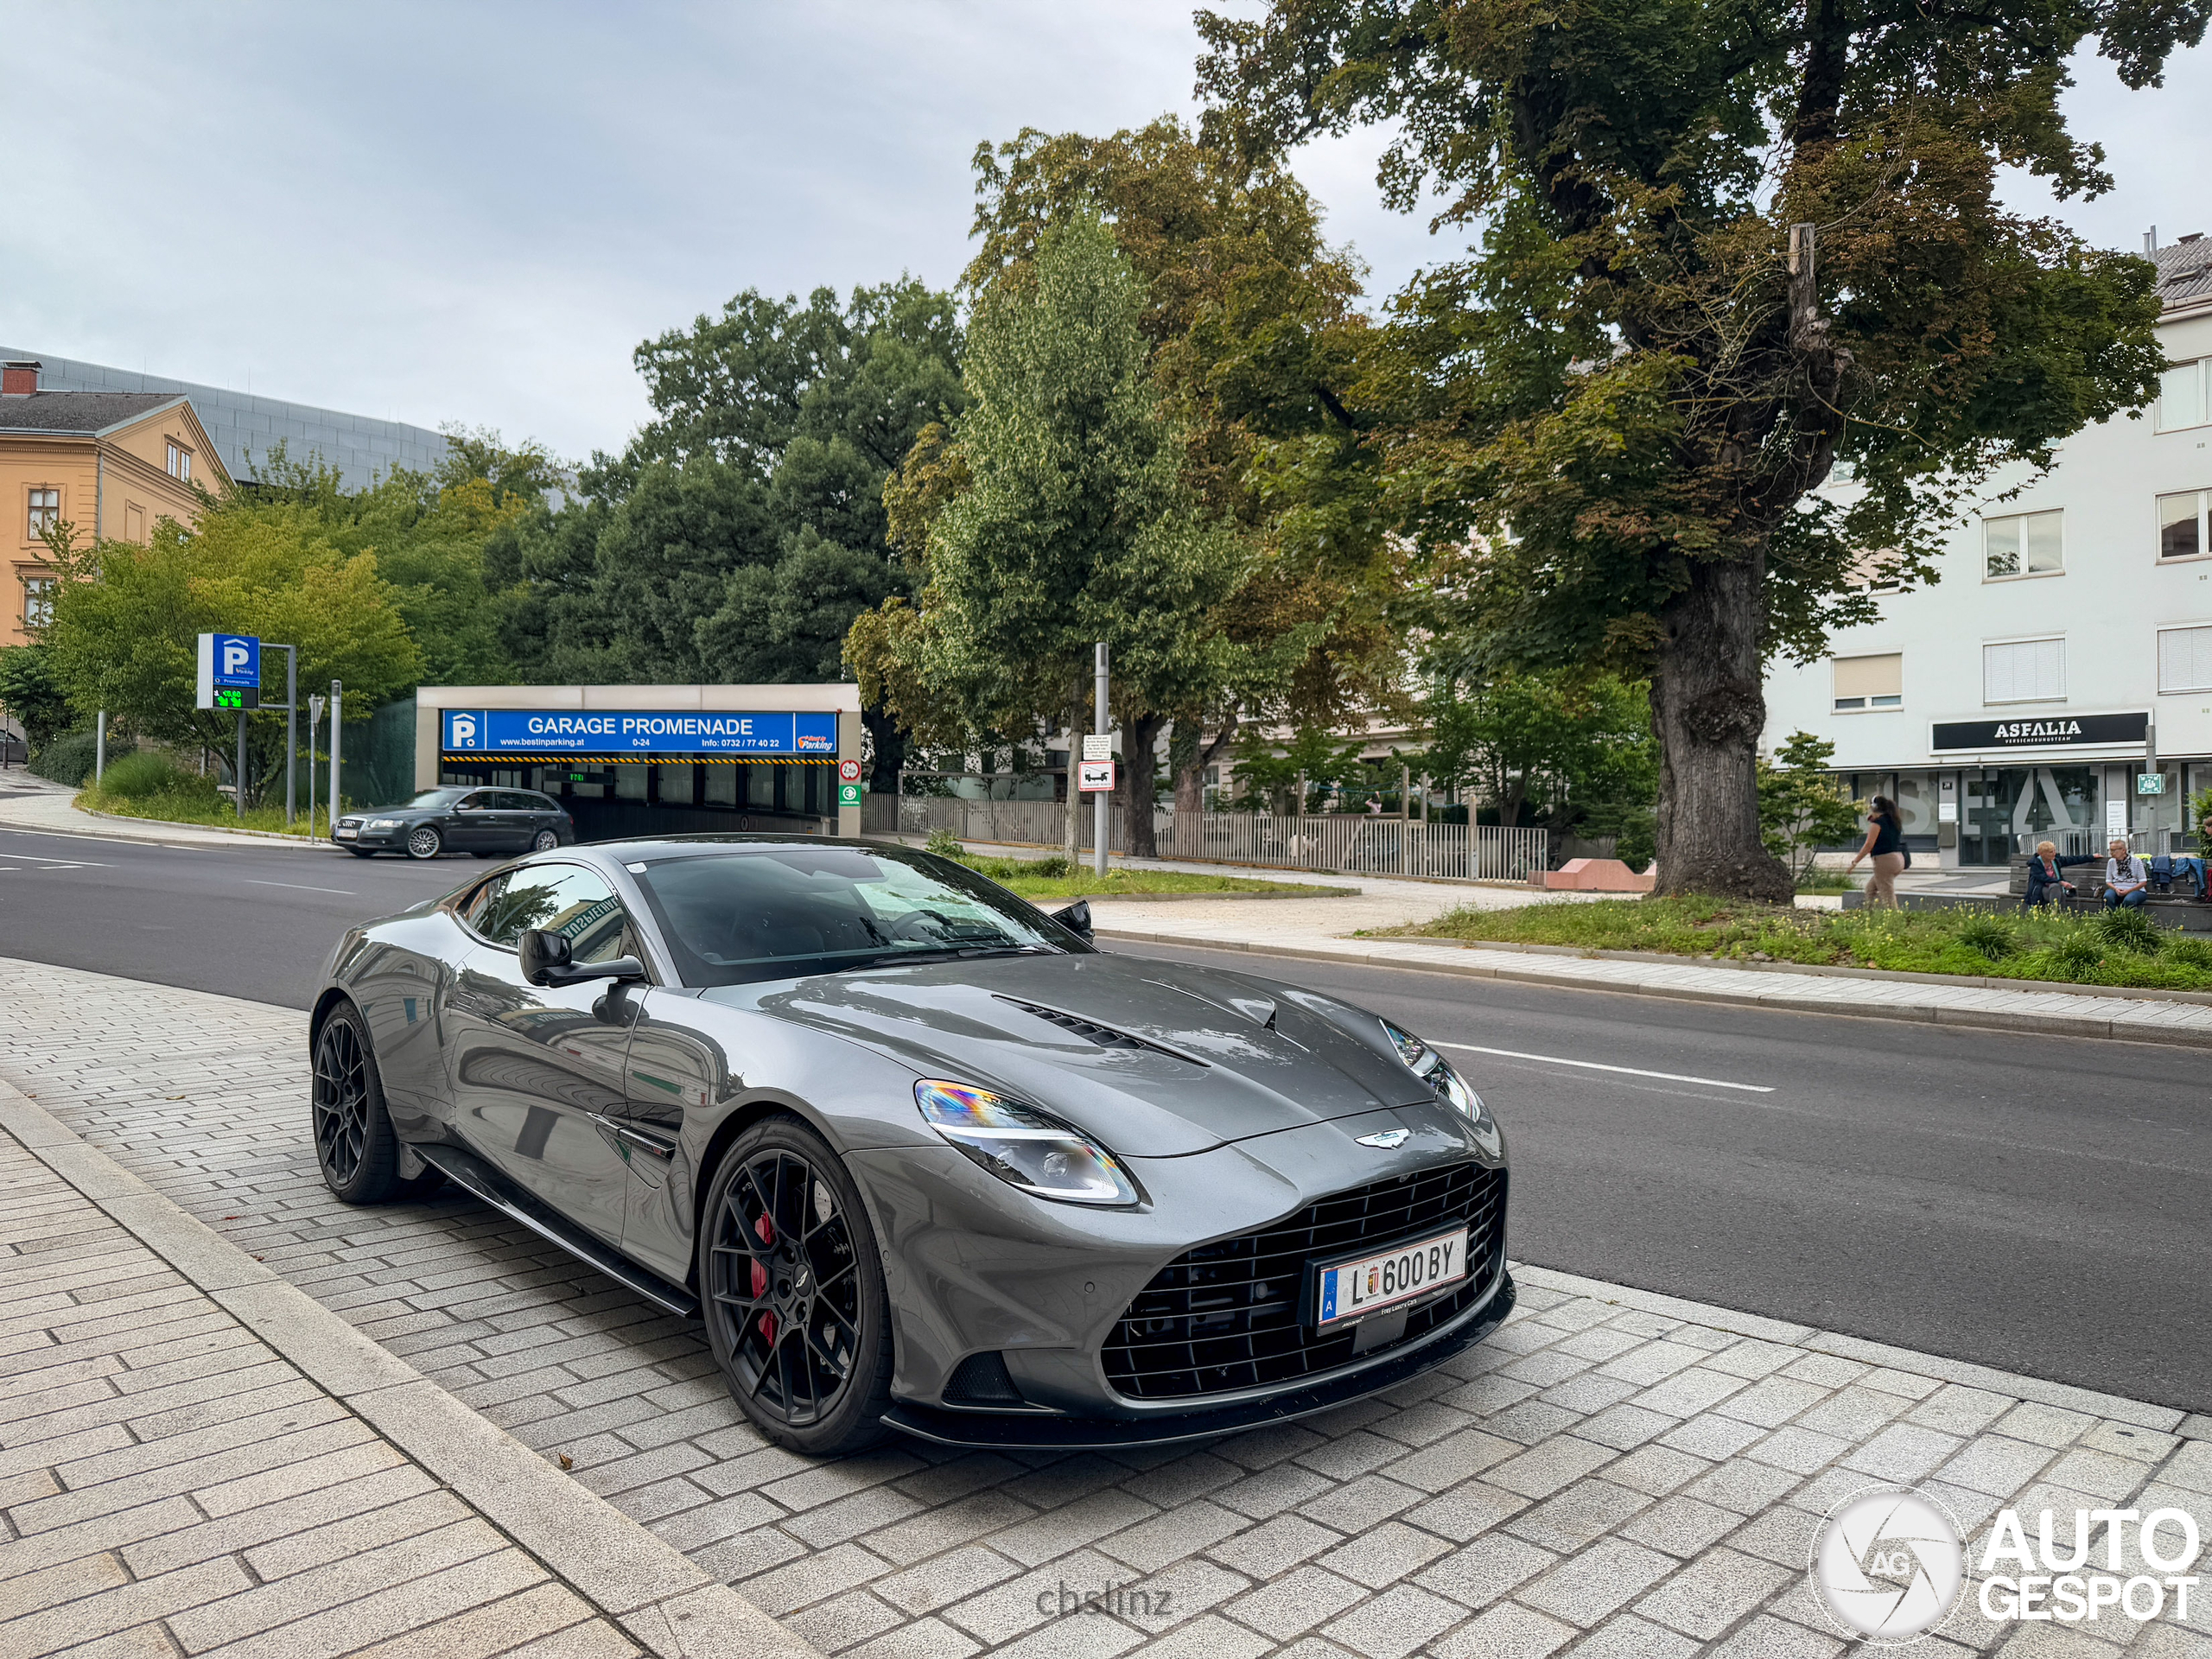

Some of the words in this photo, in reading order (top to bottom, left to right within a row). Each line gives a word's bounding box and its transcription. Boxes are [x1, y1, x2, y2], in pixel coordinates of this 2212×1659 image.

[224, 646, 250, 675] P
[453, 721, 476, 747] P
[528, 717, 616, 734] GARAGE
[623, 718, 753, 736] PROMENADE
[1994, 721, 2082, 739] ASFALIA
[500, 738, 584, 747] www.bestinparking.at
[632, 738, 650, 747] 0-24
[702, 739, 720, 747] Info:
[721, 739, 741, 747] 0732
[747, 739, 757, 747] 77
[758, 739, 768, 747] 40
[769, 739, 779, 747] 22
[802, 741, 833, 751] Parking
[1352, 1268, 1363, 1305] L
[1382, 1250, 1423, 1294] 600
[1428, 1240, 1453, 1281] BY
[1325, 1301, 1332, 1312] A
[1381, 1305, 1392, 1315] Frey
[1392, 1301, 1407, 1313] Luxury
[1408, 1298, 1417, 1307] Cars
